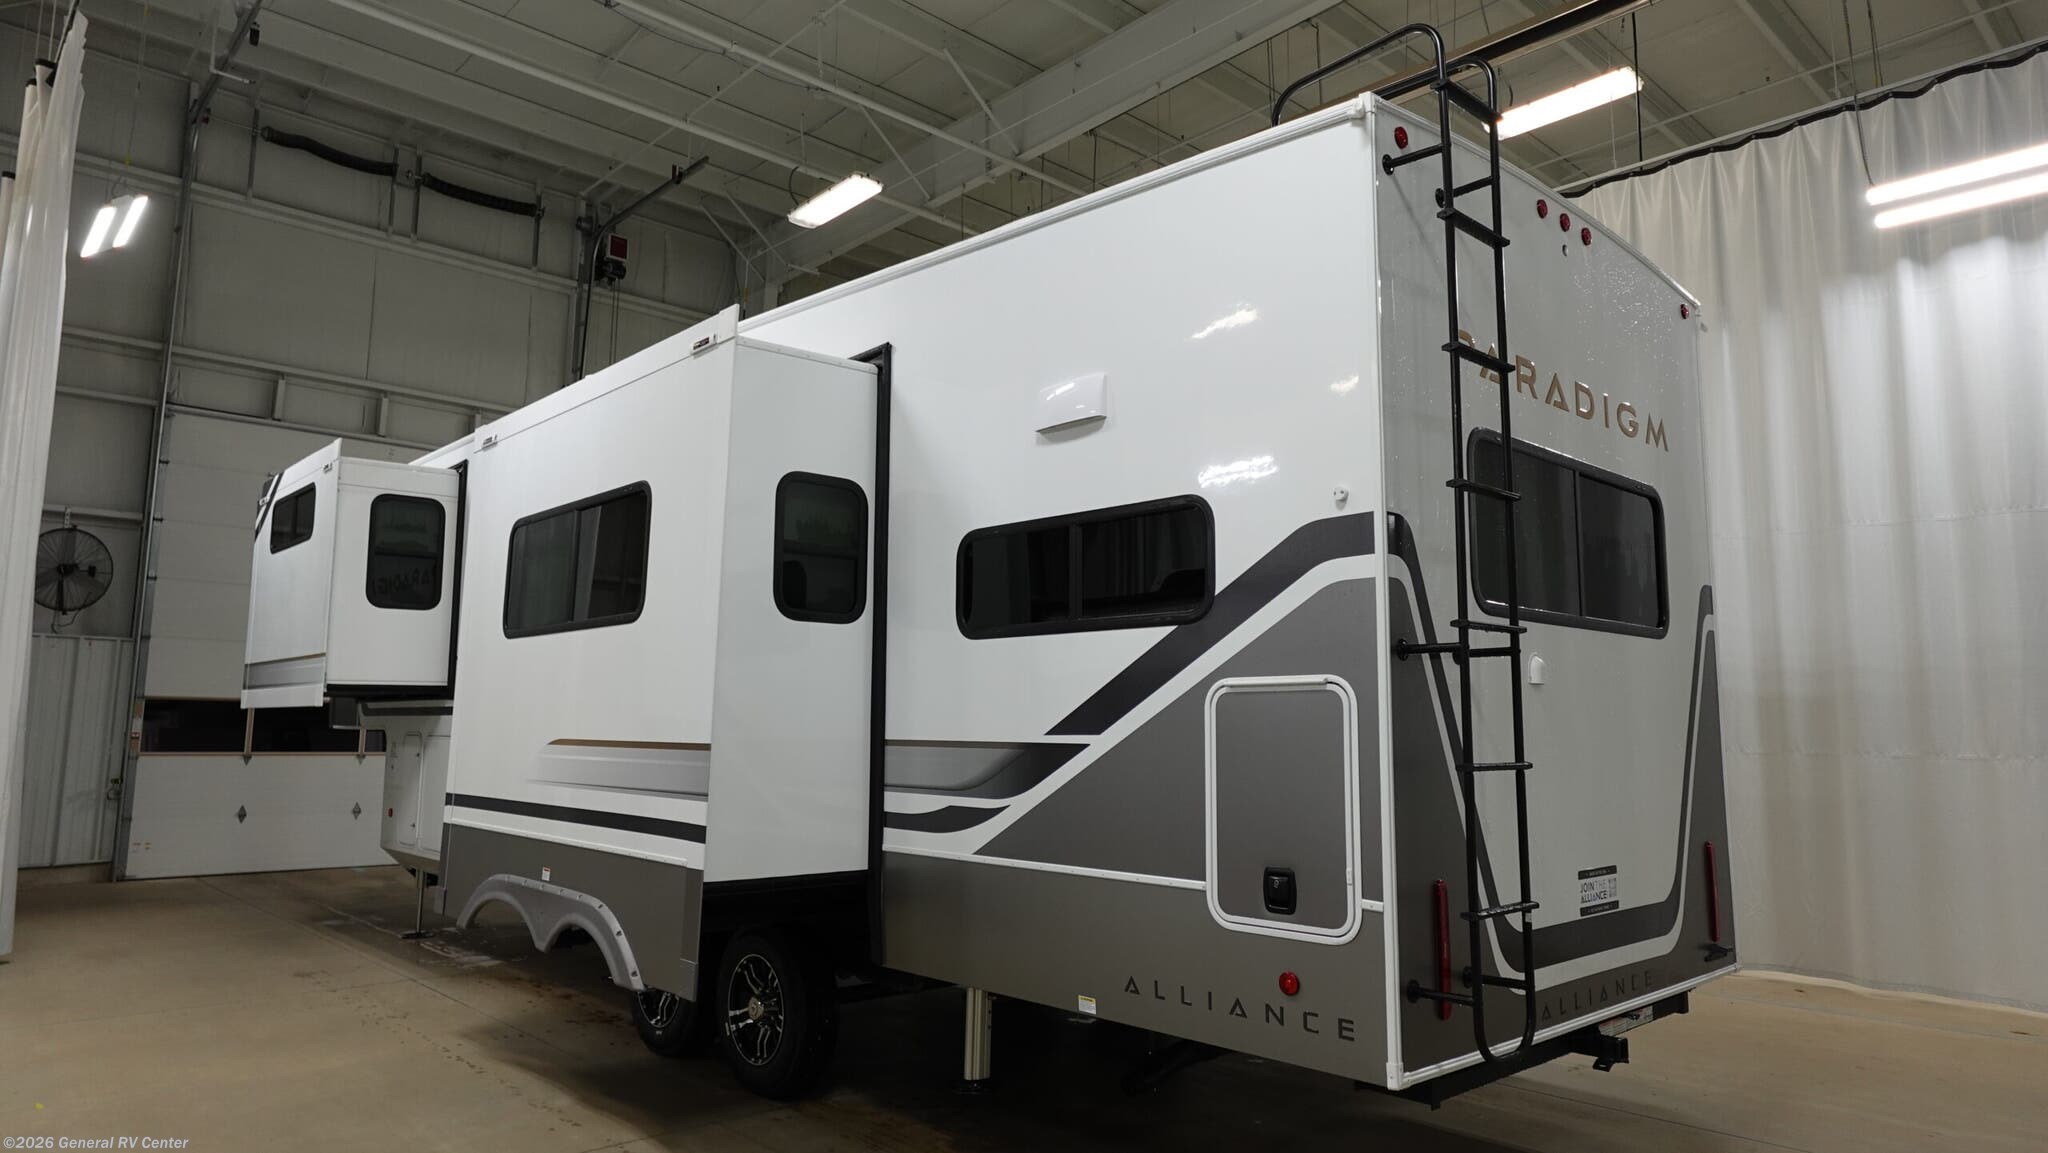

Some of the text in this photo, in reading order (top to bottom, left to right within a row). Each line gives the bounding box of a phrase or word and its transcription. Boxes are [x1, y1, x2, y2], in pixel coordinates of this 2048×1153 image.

[1580, 881, 1594, 893] JOIN
[1124, 975, 1355, 1042] ALLIANCE
[1541, 971, 1653, 1022] ALLIANCE
